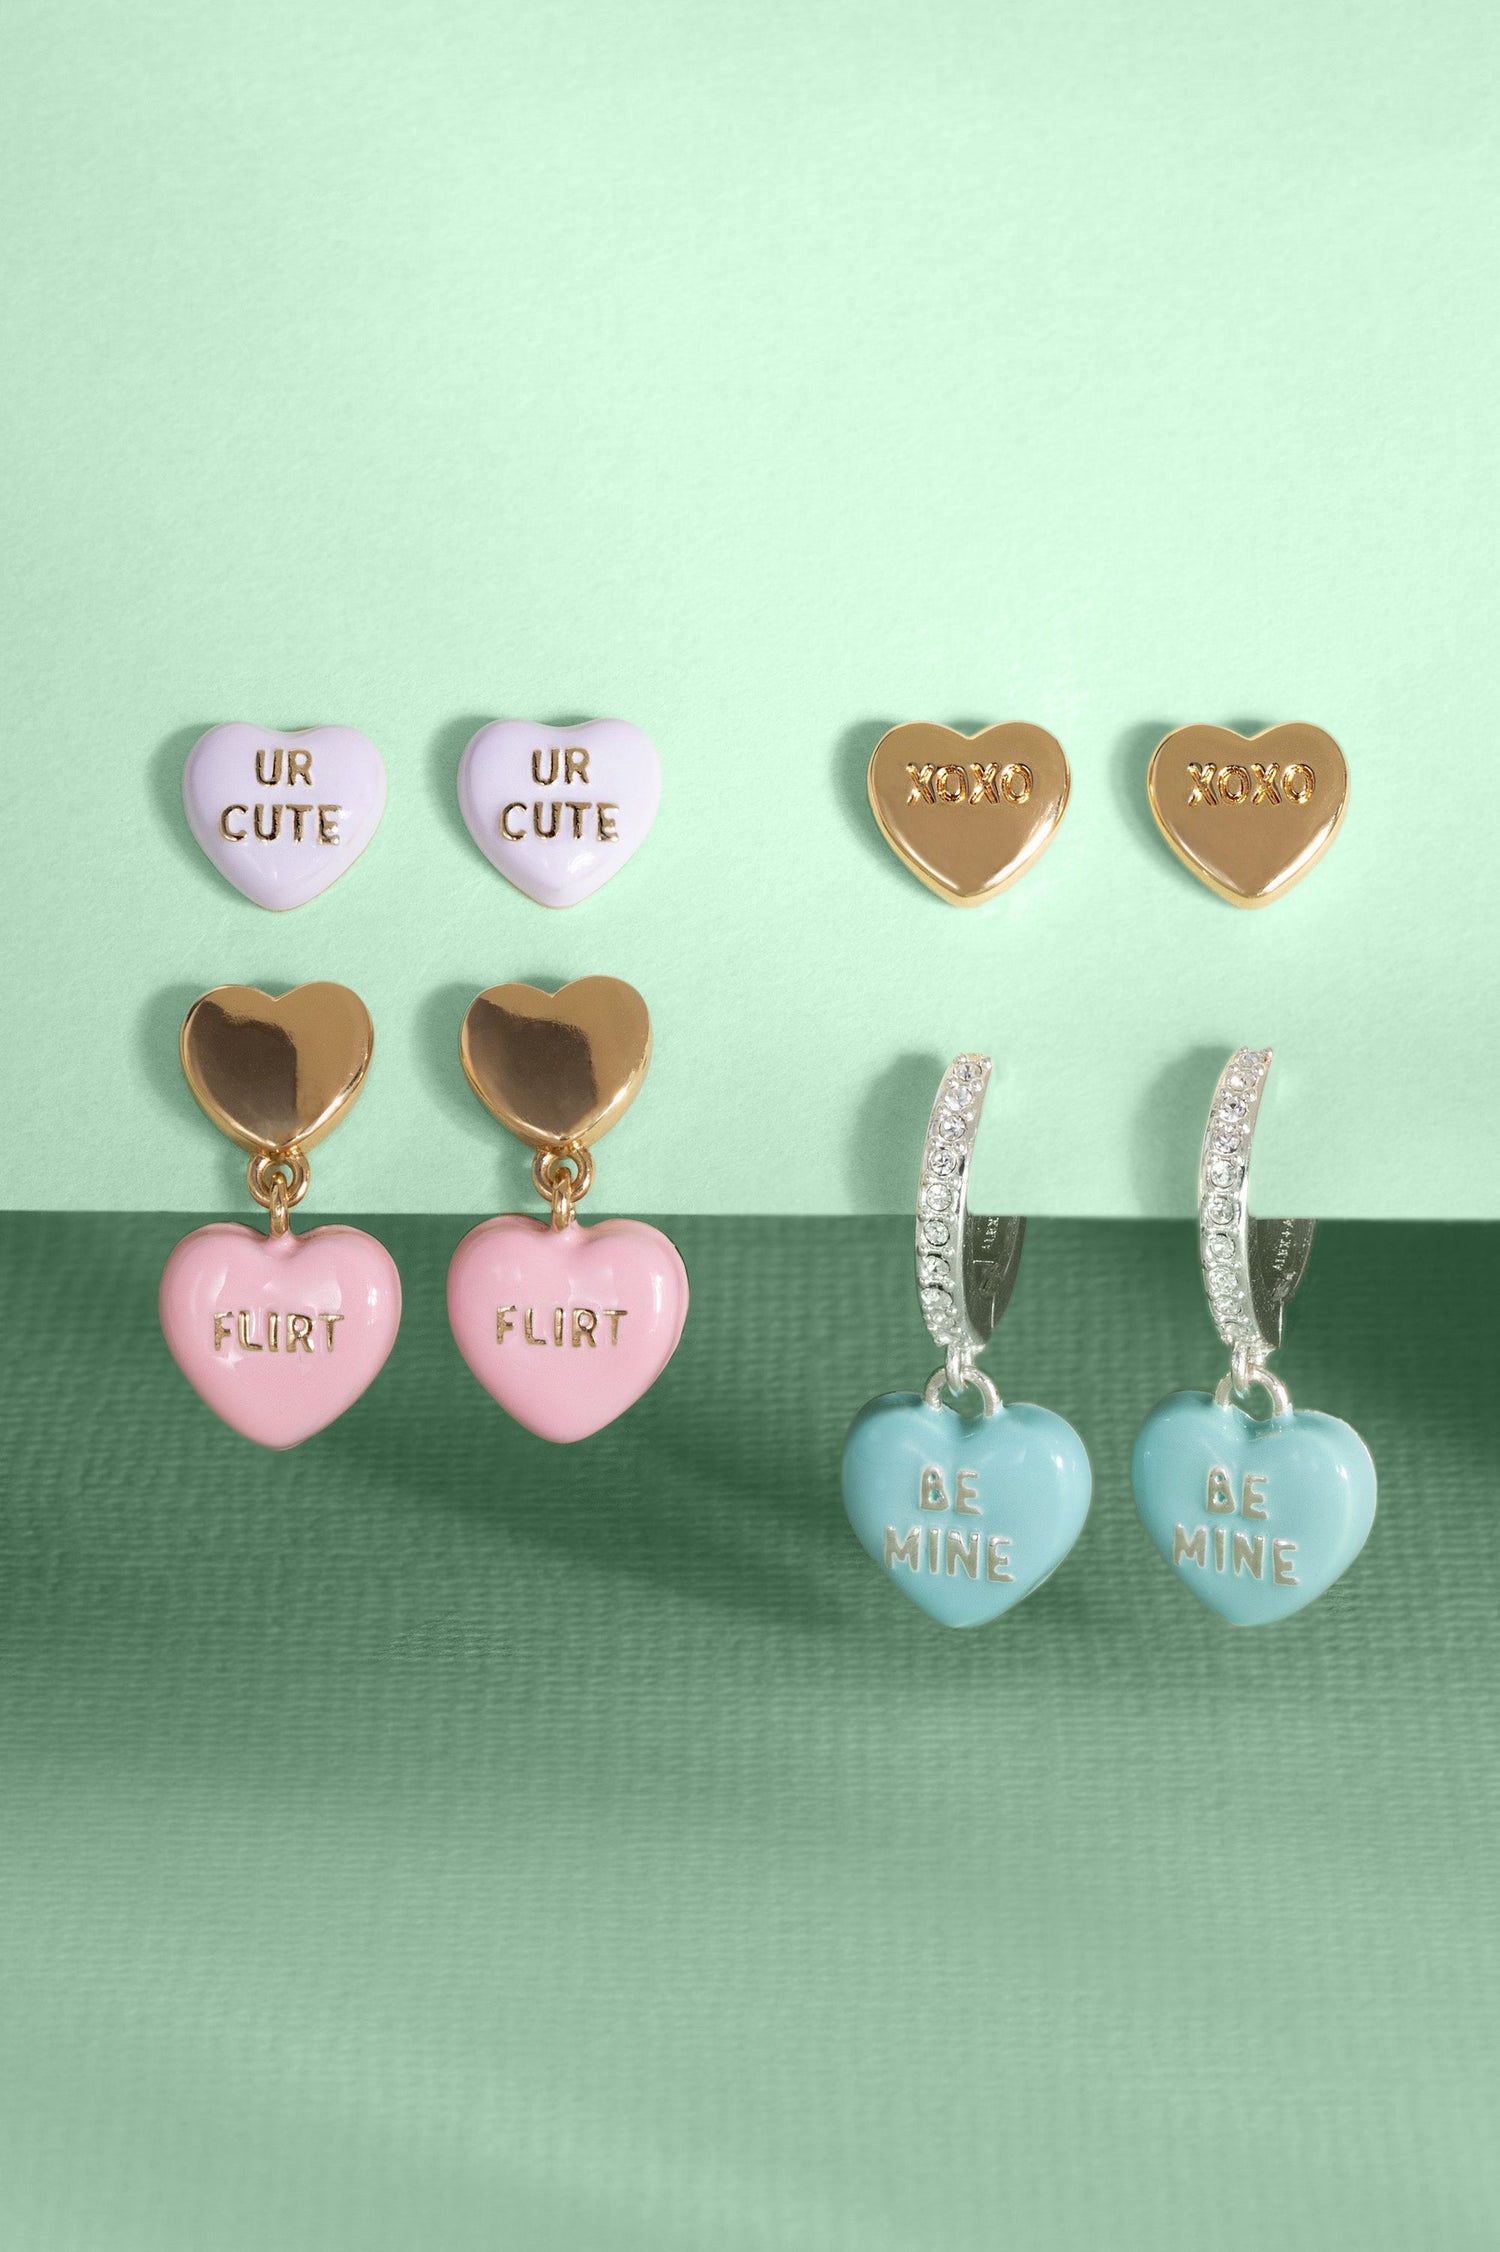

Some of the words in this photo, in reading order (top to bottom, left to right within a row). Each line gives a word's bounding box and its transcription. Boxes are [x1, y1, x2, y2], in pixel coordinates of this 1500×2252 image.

[256, 748, 313, 786] UR
[532, 747, 591, 786] UR
[906, 762, 1034, 805] XOXO
[1187, 762, 1316, 806] XOXO
[219, 803, 342, 846] CUTE
[500, 801, 620, 842] CUTE
[213, 1310, 345, 1353] FLIRT
[496, 1305, 628, 1348] FLIRT
[920, 1466, 982, 1516] BE
[1206, 1466, 1269, 1520] BE
[884, 1525, 1015, 1583] MINE
[1173, 1524, 1299, 1586] MINE
